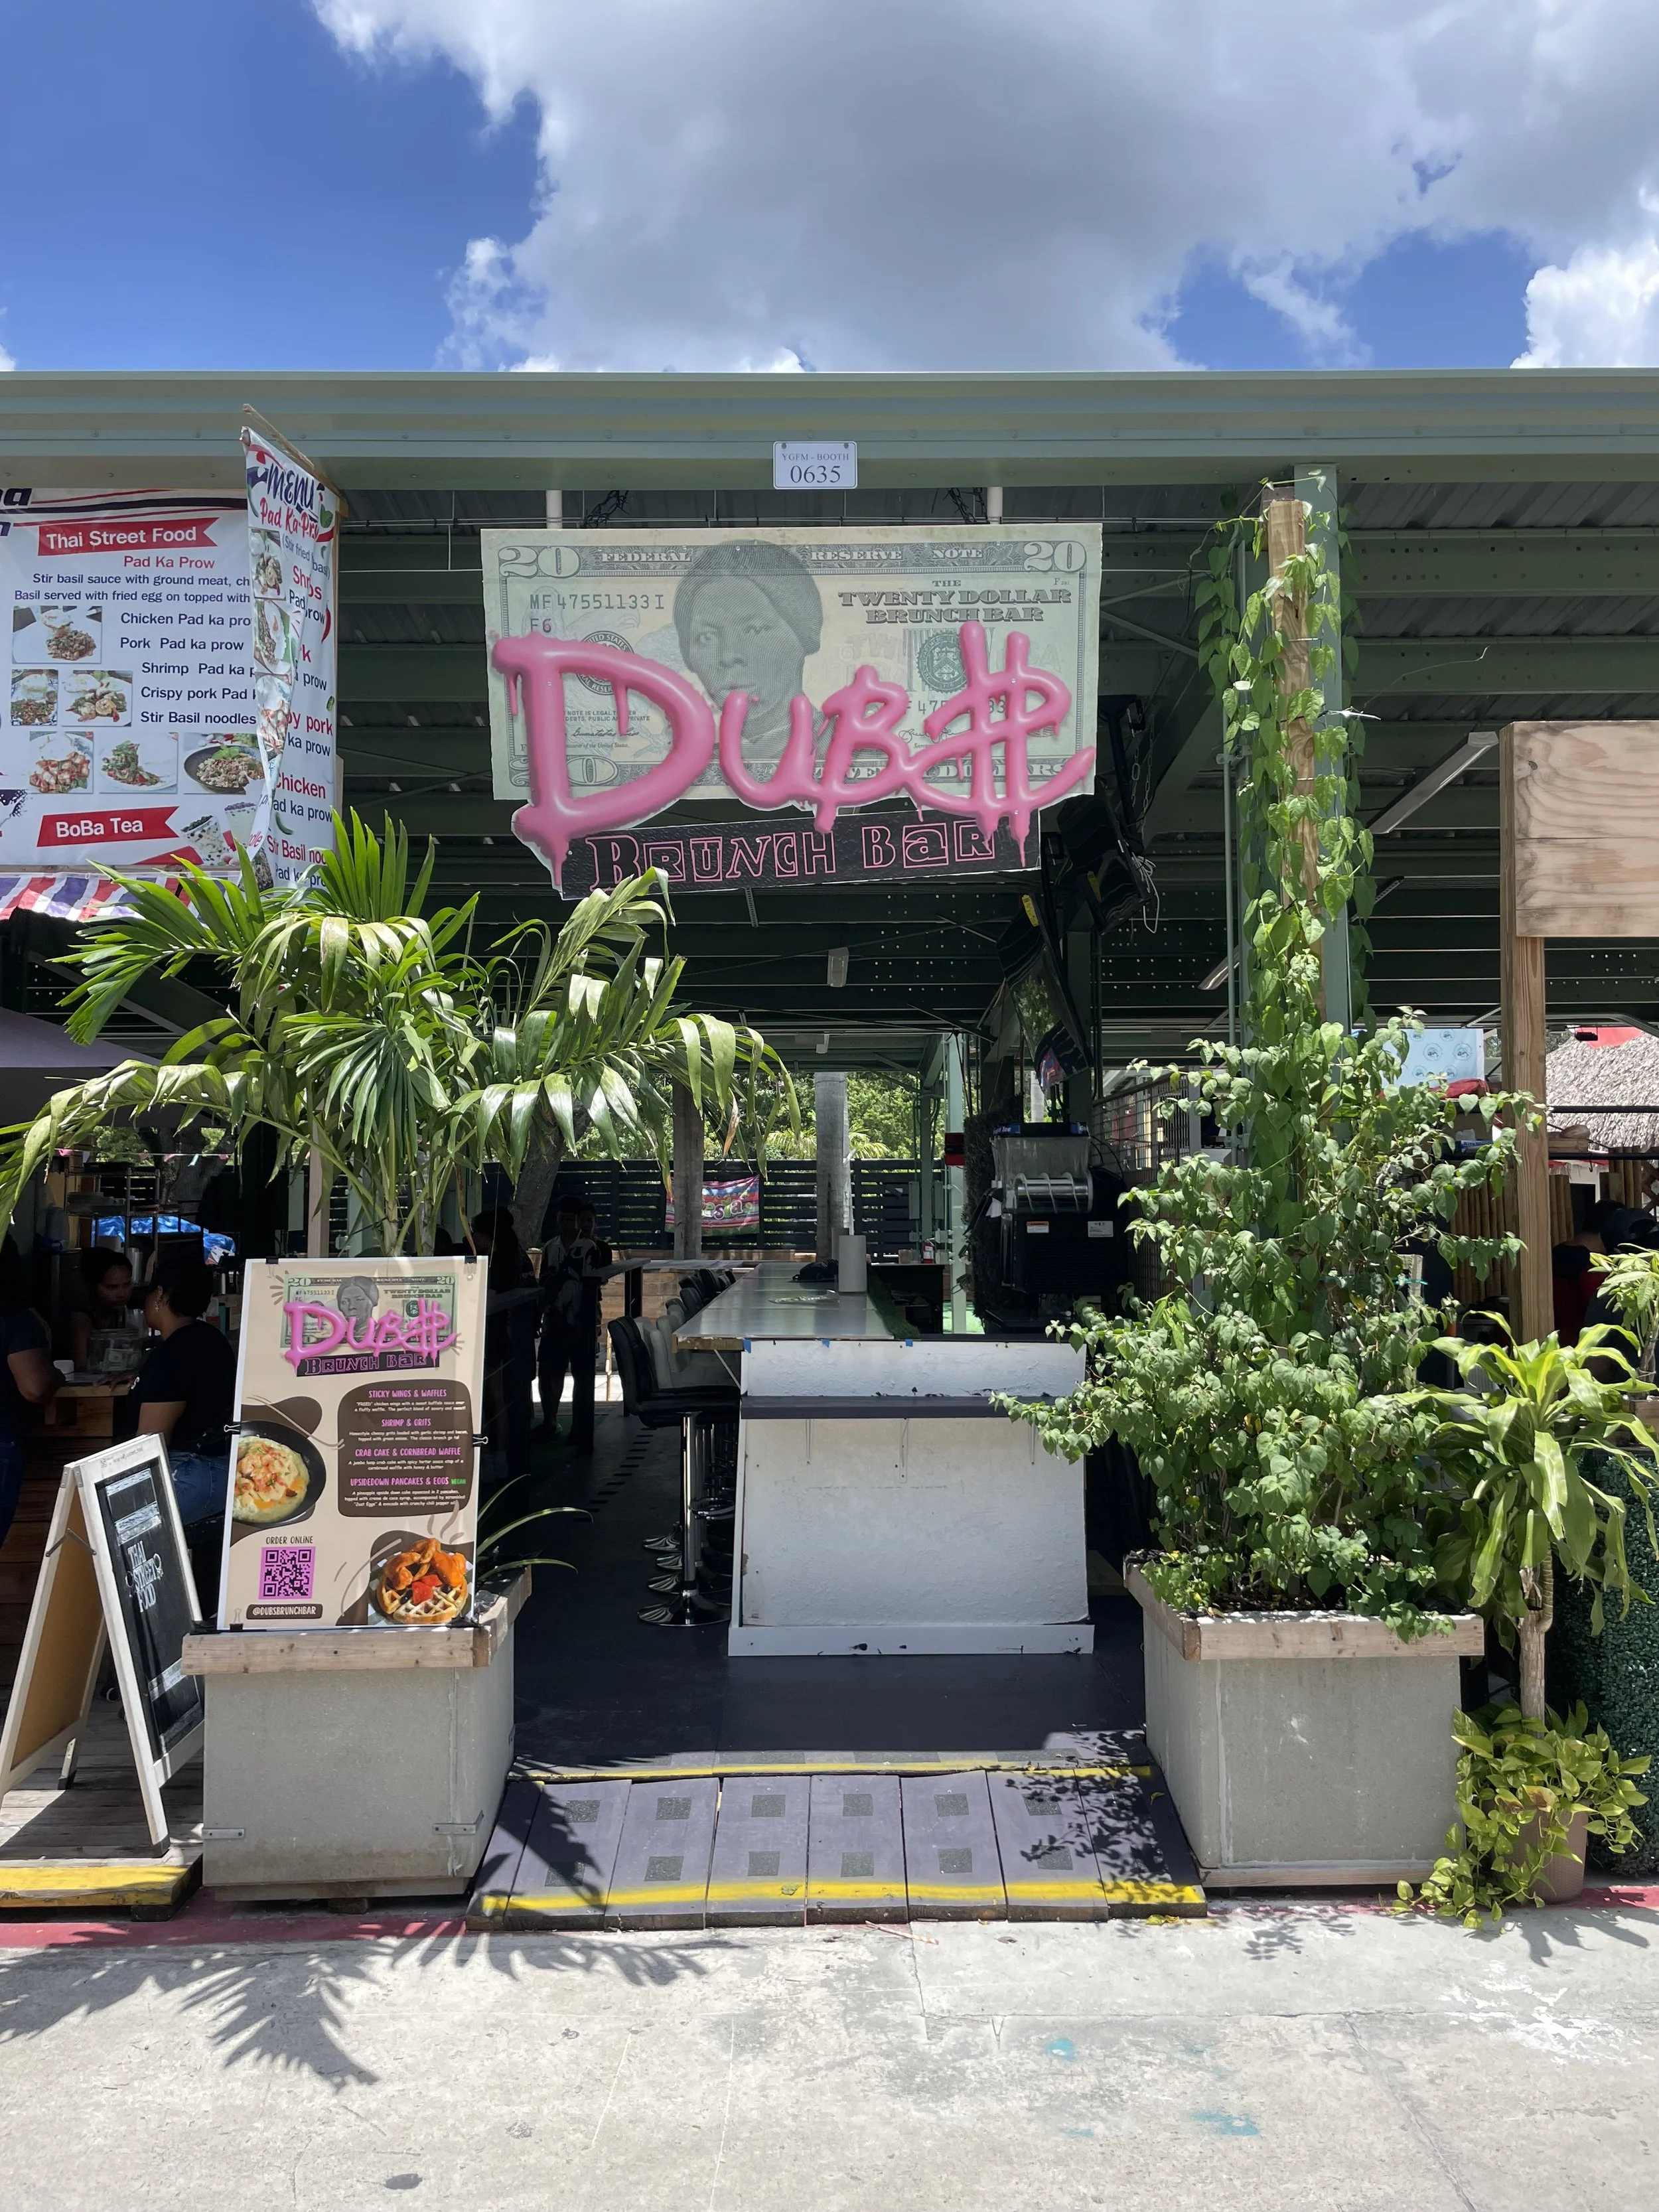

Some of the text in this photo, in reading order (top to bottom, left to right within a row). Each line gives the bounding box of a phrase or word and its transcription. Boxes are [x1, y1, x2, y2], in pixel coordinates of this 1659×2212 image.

[790, 465, 841, 483] 0635
[267, 463, 315, 510] MENU
[259, 497, 282, 528] Pad
[46, 527, 197, 550] Thai Street Food
[124, 556, 215, 569] Pad Ka Prow
[498, 541, 1087, 579] 20 FEDERAL RESERVE NOTE 20
[33, 573, 53, 584] Stir
[57, 573, 83, 584] basil
[88, 576, 121, 585] sauce
[125, 574, 149, 585] with
[153, 575, 194, 587] ground
[198, 576, 232, 587] meat,
[15, 590, 250, 604] Basil served with fried egg on topped with
[289, 589, 305, 610] Pad
[838, 589, 1072, 607] TWENTY DOLLAR
[121, 613, 252, 628] Chicken Pad ka pro
[865, 607, 1045, 624] BRUNCH BAR
[121, 637, 244, 652] Pork Pad ka prow
[606, 635, 627, 650] STATES
[141, 662, 189, 678] Shrimp
[198, 663, 224, 675] Pad
[229, 664, 245, 676] ka
[303, 672, 327, 691] prow
[591, 683, 613, 693] RESER
[141, 686, 182, 701] Crispy
[188, 688, 217, 701] pork
[222, 688, 248, 700] Pad
[141, 711, 257, 725] Stir Basil noodles
[306, 715, 333, 736] pork
[287, 732, 330, 757] ka prow
[273, 798, 286, 812] ad
[290, 800, 304, 816] ka
[307, 806, 332, 823] prow
[56, 816, 143, 838] BoBa Tea
[281, 840, 306, 861] Basil
[586, 832, 835, 891] BRUNCH
[288, 1278, 311, 1287] 20
[437, 1276, 455, 1285] 20
[305, 1357, 380, 1375] BRUNCH
[399, 1447, 437, 1456] CORNBREAD
[253, 1606, 316, 1615] @DUBSBRUNCHBAR
